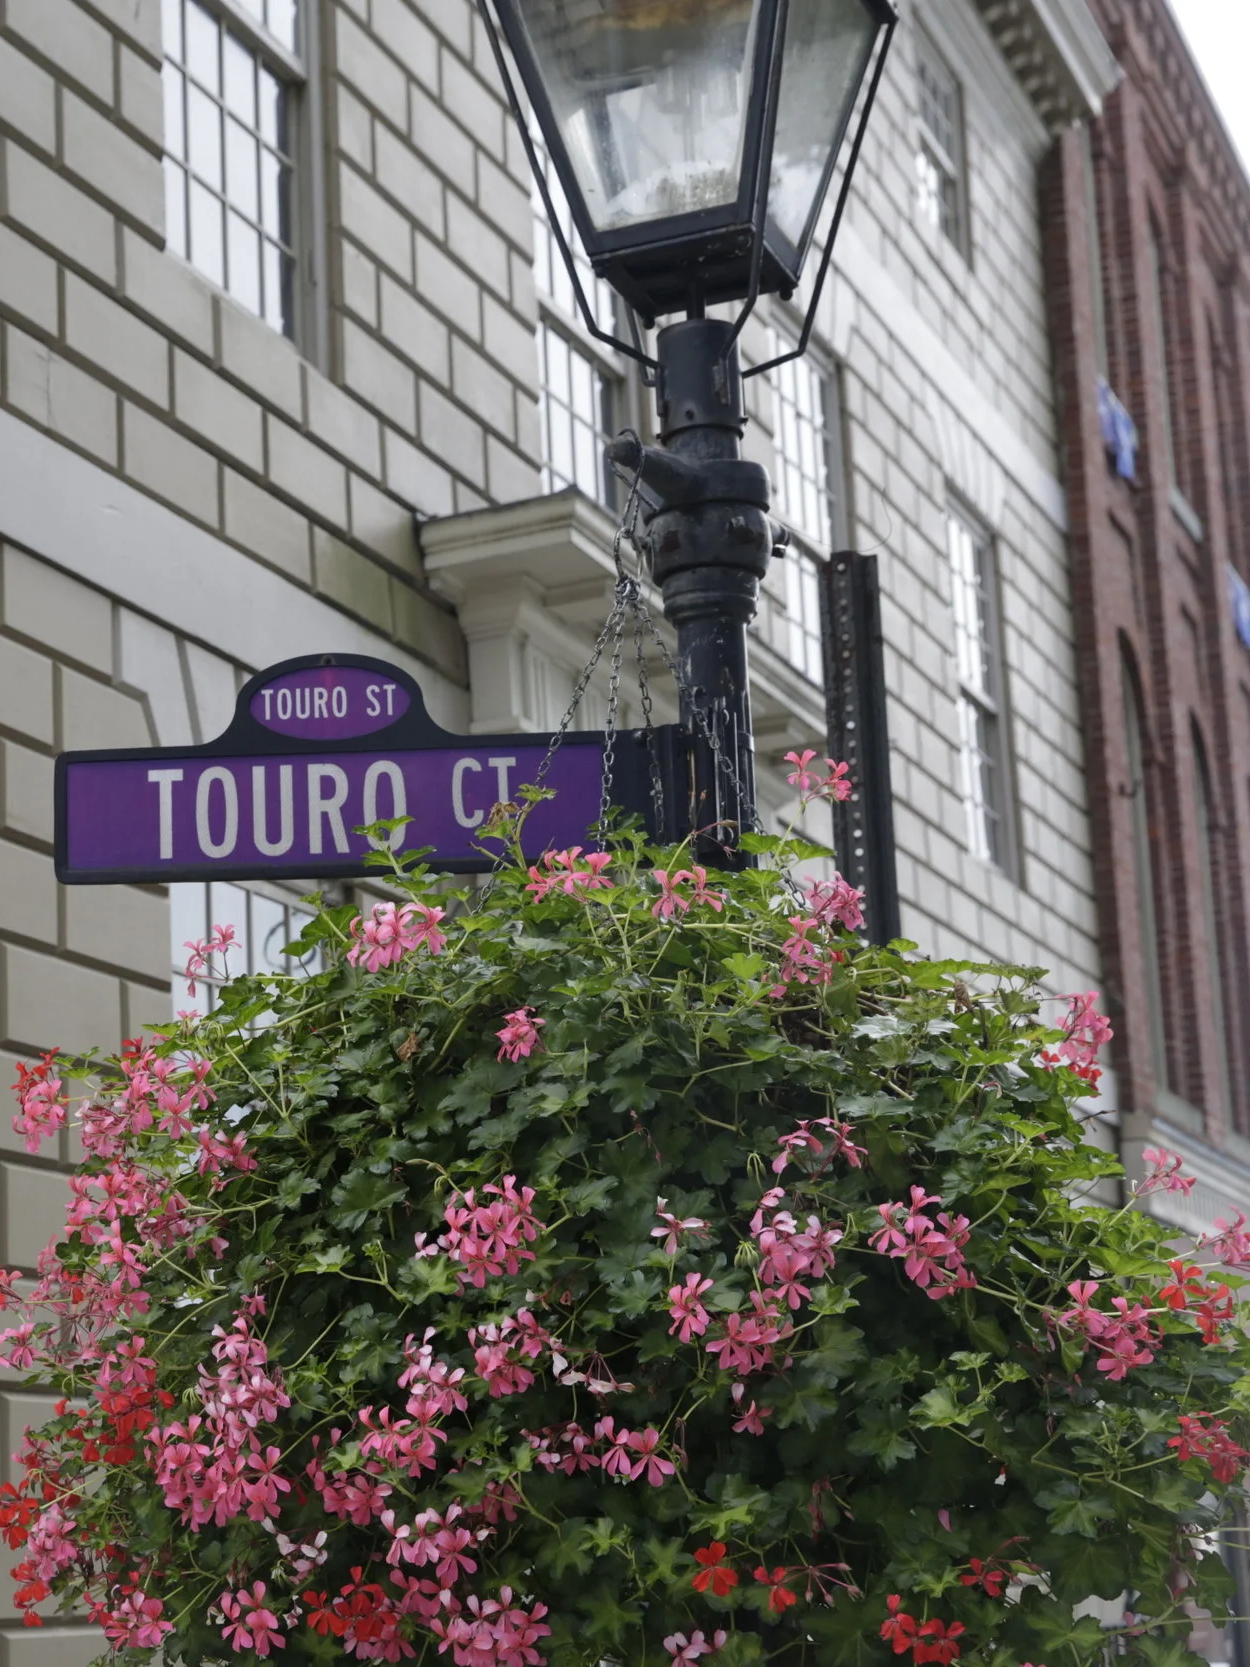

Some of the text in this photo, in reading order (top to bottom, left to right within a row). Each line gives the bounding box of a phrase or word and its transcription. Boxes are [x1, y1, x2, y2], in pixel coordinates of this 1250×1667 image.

[260, 683, 397, 721] TOURO ST
[147, 756, 518, 860] TOURO CT
